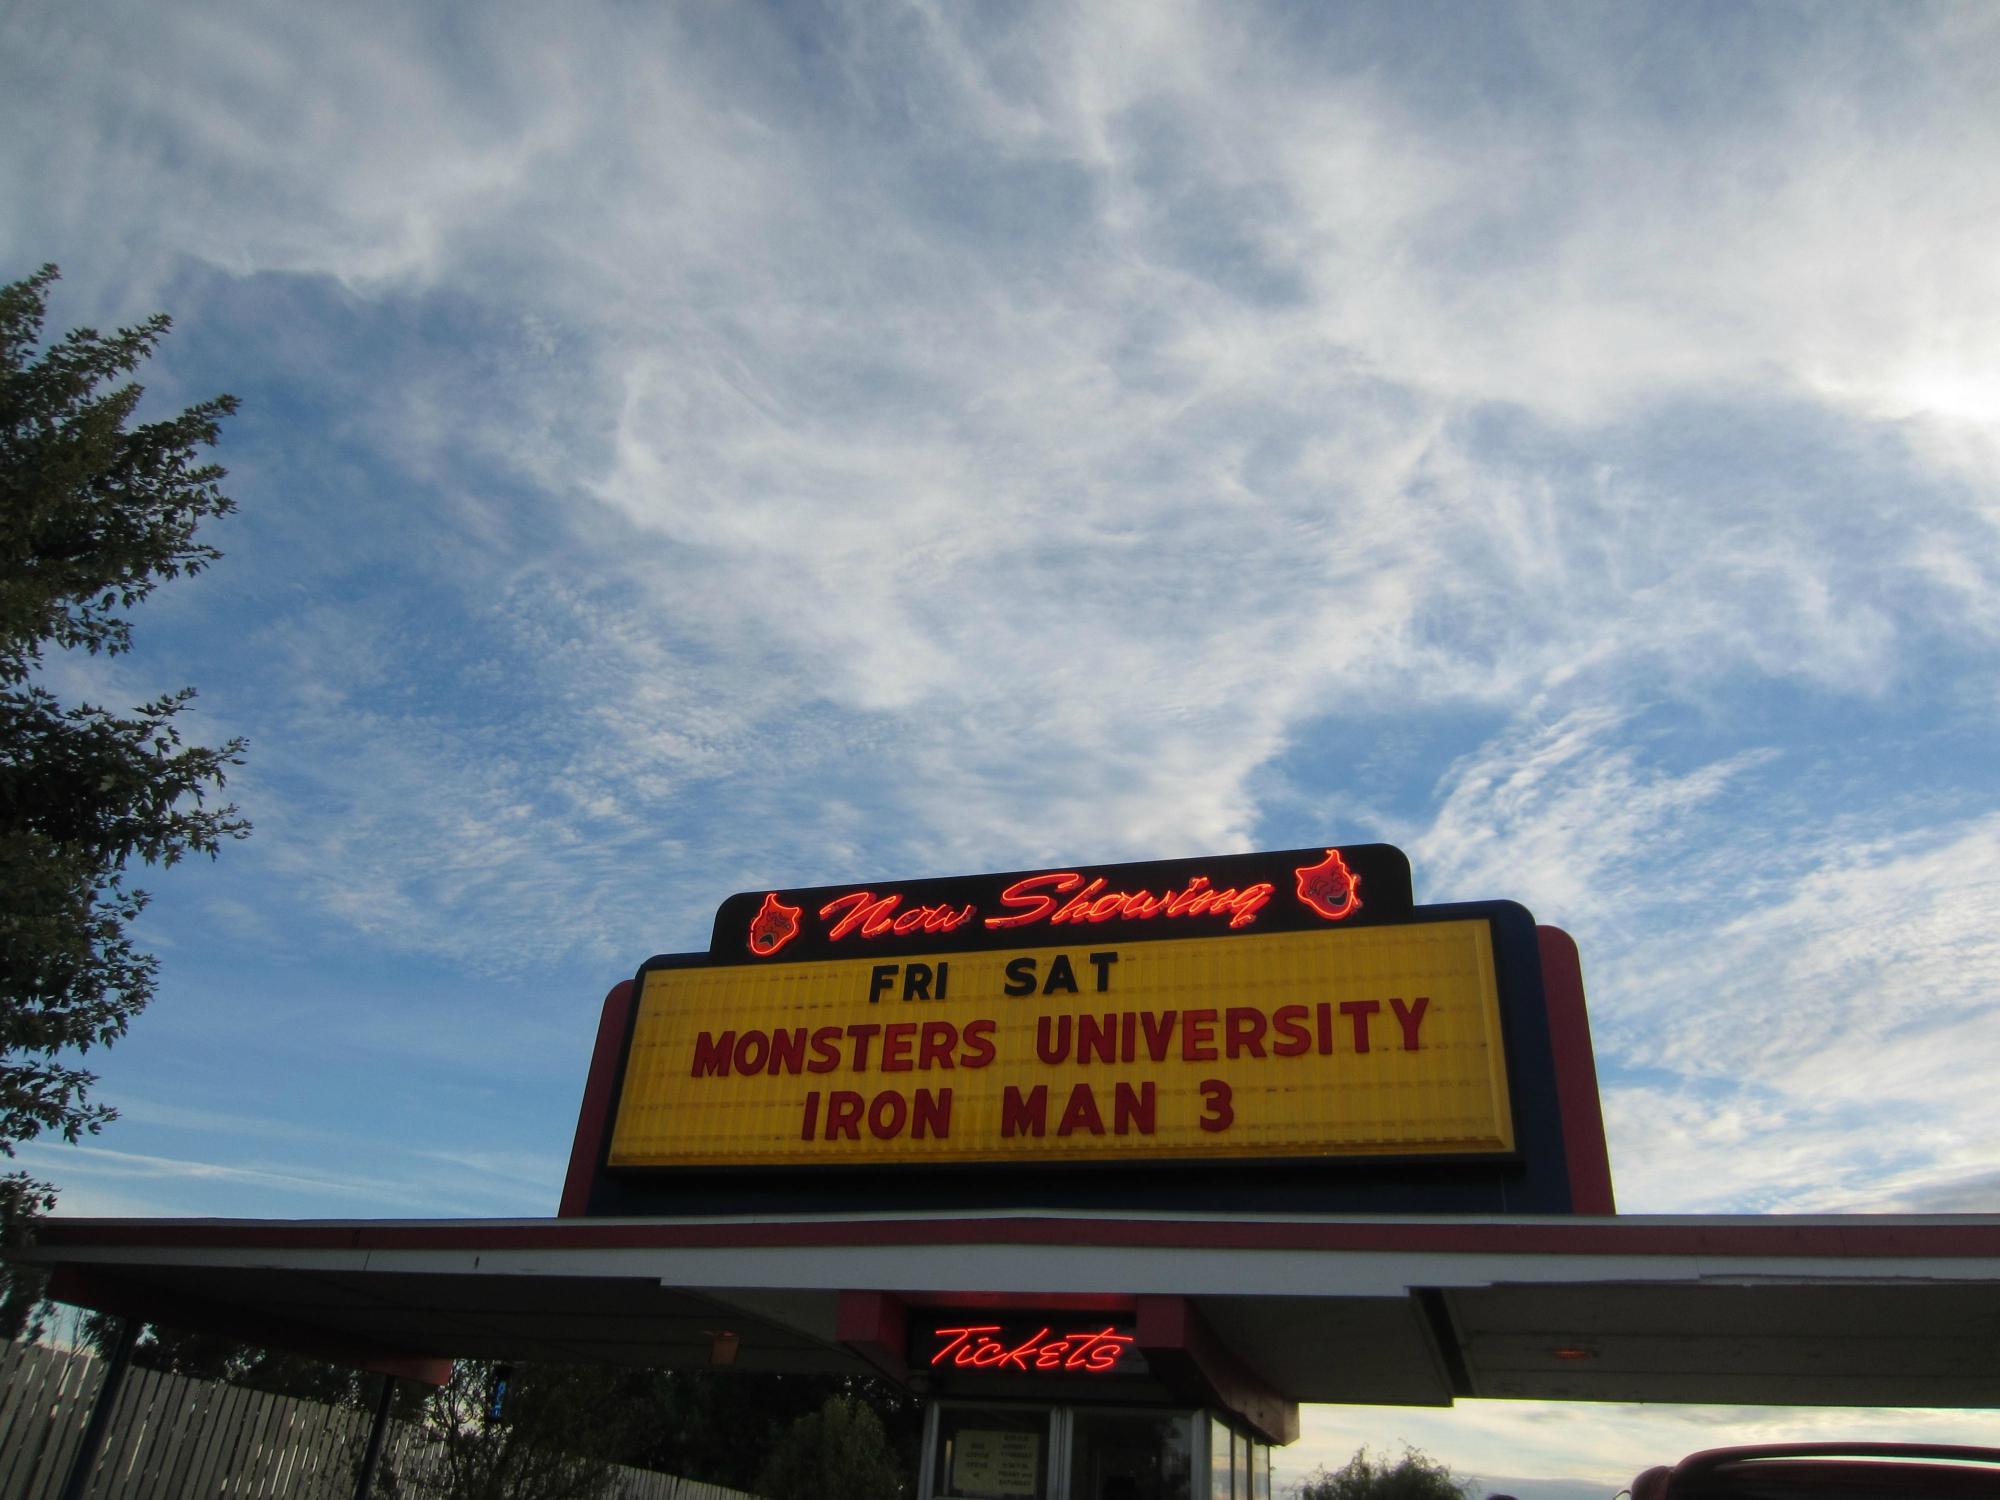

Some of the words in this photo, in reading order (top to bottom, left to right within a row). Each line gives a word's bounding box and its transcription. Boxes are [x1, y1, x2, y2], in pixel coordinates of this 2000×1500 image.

[819, 890, 977, 941] Now
[985, 872, 1275, 929] Showing
[869, 962, 949, 1002] FRI
[1003, 951, 1118, 997] SAT
[691, 1020, 996, 1078] MONSTERS
[1036, 997, 1429, 1065] UNIVERSITY
[801, 1088, 952, 1140] IRON
[1001, 1082, 1156, 1137] MAN
[1199, 1079, 1235, 1133] 3
[931, 1326, 1134, 1371] Tickets
